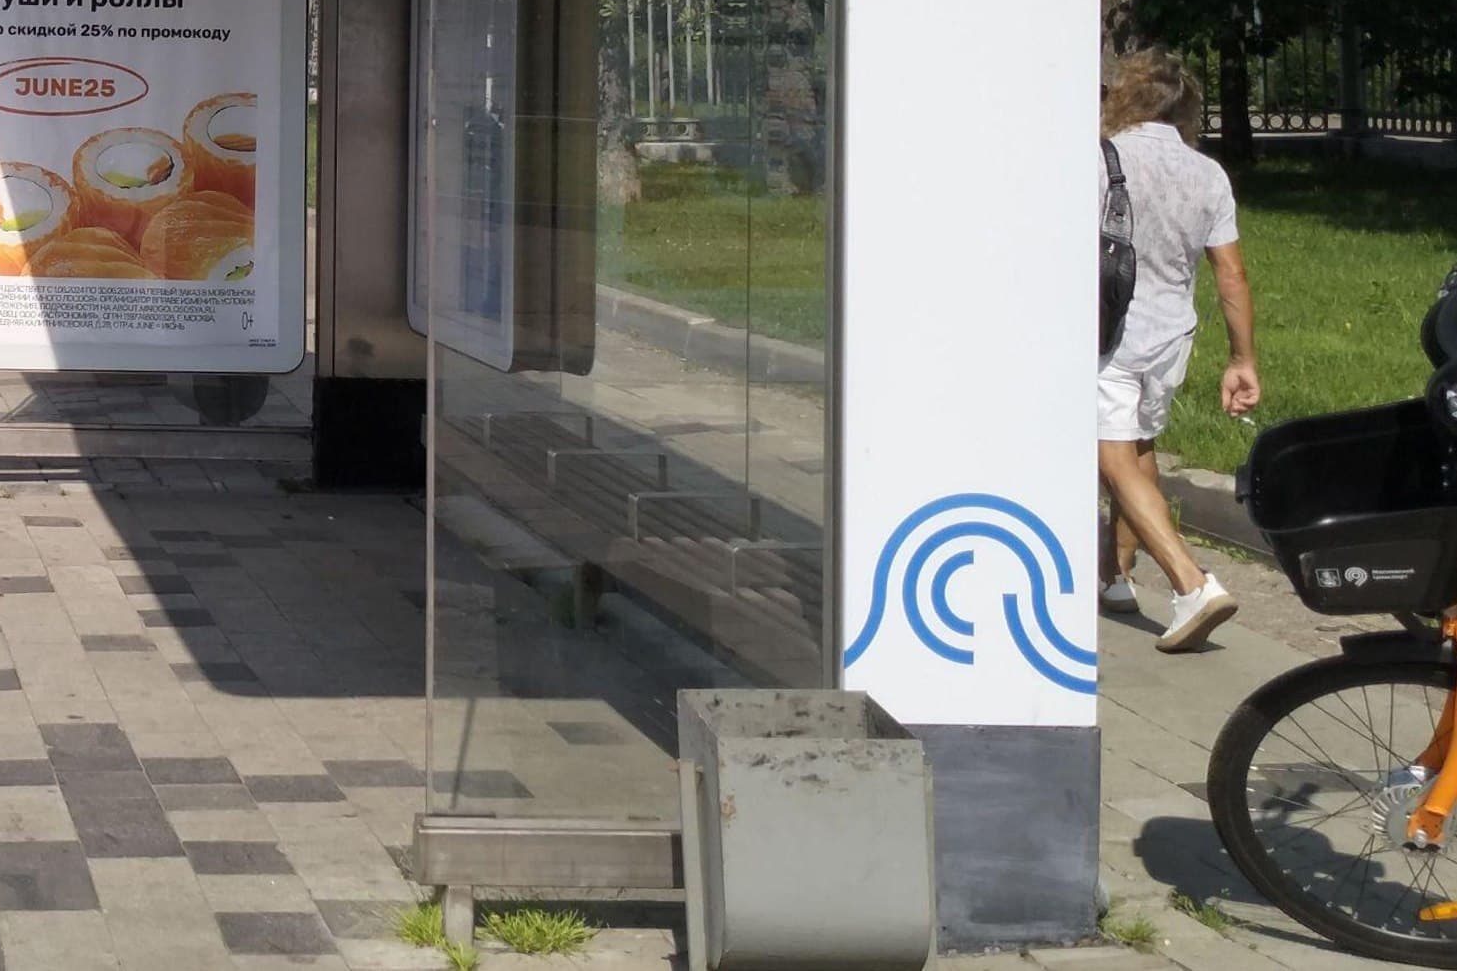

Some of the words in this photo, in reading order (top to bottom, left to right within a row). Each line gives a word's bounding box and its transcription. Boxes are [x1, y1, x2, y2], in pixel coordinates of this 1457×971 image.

[8, 23, 77, 38] скидкой
[80, 24, 114, 37] 25%
[117, 27, 137, 38] по
[141, 27, 231, 42] промокоду
[15, 77, 116, 98] JUNE25
[241, 311, 254, 330] 0+
